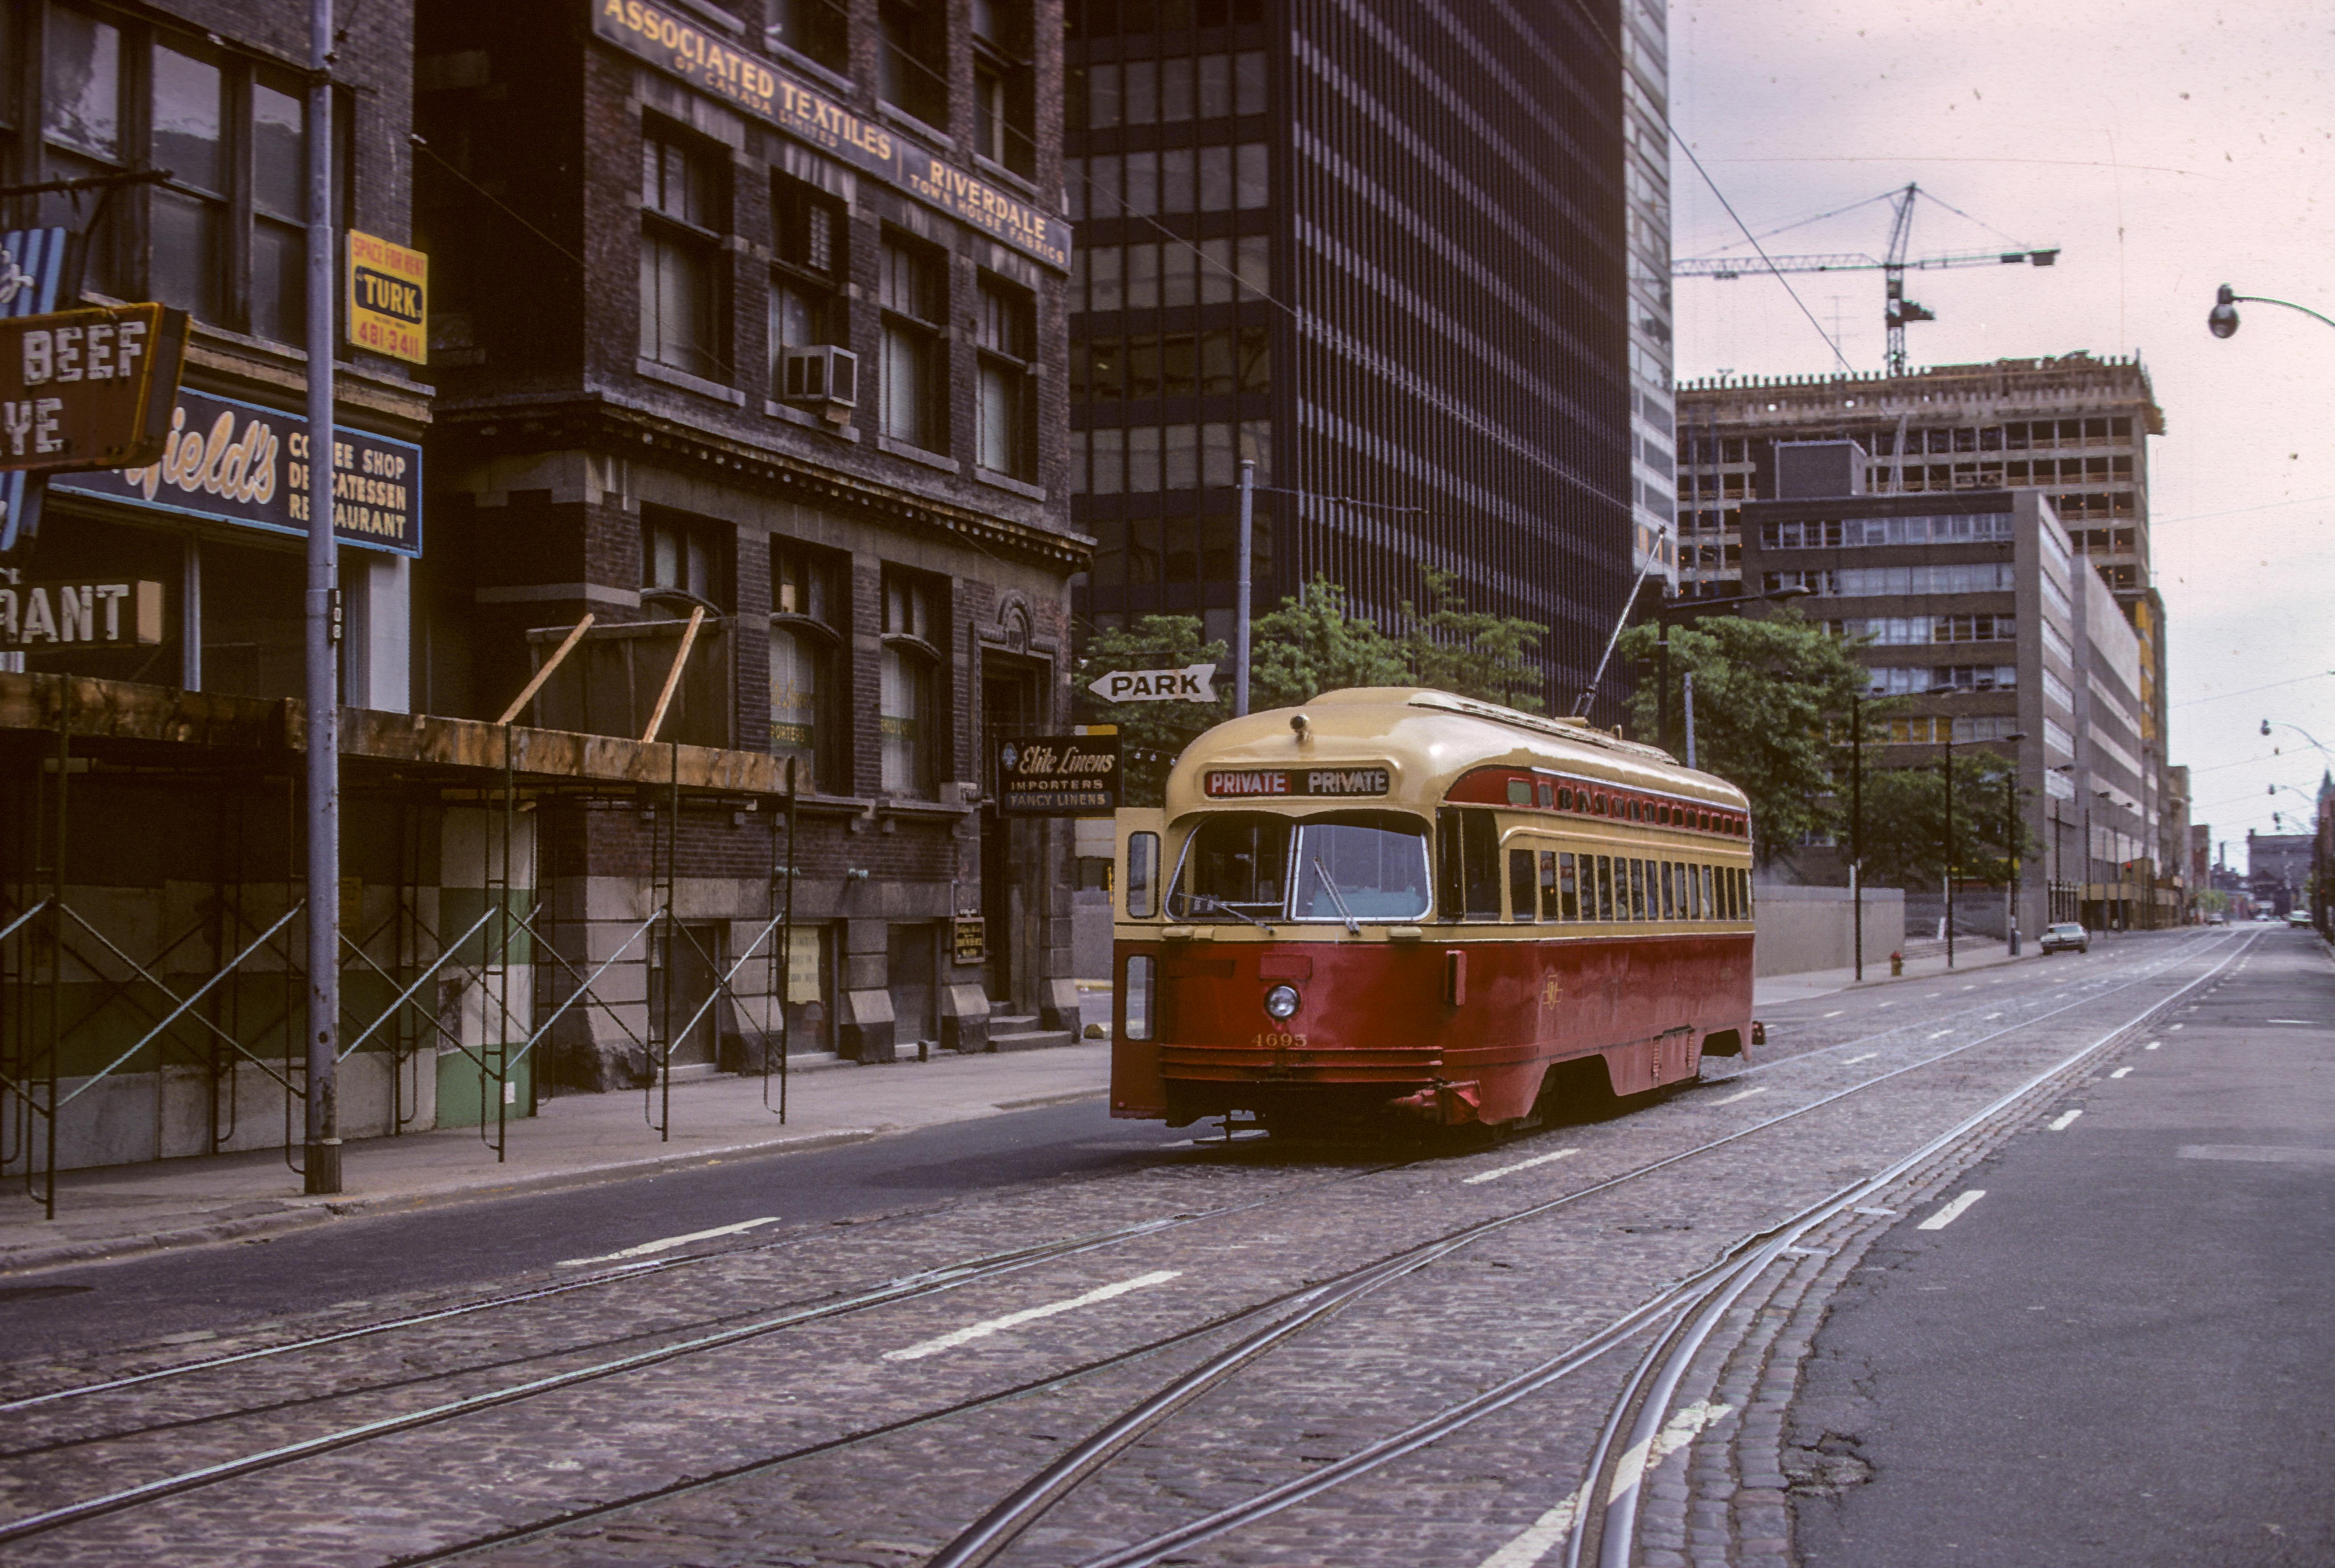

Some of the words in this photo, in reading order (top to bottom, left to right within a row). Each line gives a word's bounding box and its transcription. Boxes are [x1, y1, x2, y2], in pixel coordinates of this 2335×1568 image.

[604, 0, 774, 99] ASSOCIATED
[781, 81, 890, 160] TEXTILES
[674, 56, 696, 73] OF
[705, 72, 772, 115] CANADA
[779, 110, 837, 148] LIMITED
[910, 174, 952, 207] TOWN
[957, 198, 1001, 232] HOUSE
[1009, 226, 1064, 263] FABRICS
[930, 160, 1046, 240] RIVERDALE
[354, 237, 383, 265] SPACE
[386, 247, 403, 271] FOR
[363, 274, 416, 318] TURK
[23, 321, 146, 386] BEEF
[358, 322, 420, 357] 481-3411
[0, 398, 63, 455] YE
[362, 449, 406, 480] SHOP
[288, 461, 406, 511] DEATESSEN
[289, 493, 406, 539] REAURANT
[1112, 674, 1200, 696] PARK
[1019, 745, 1057, 774] Elite
[1057, 746, 1115, 774] Linens
[1010, 795, 1052, 807] FANCY
[1057, 794, 1106, 806] LINENS
[1011, 779, 1104, 790] IMPORTERS
[1211, 773, 1285, 793] PRIVATE
[1308, 772, 1387, 793] PRIVATE
[1252, 1033, 1307, 1046] 4695
